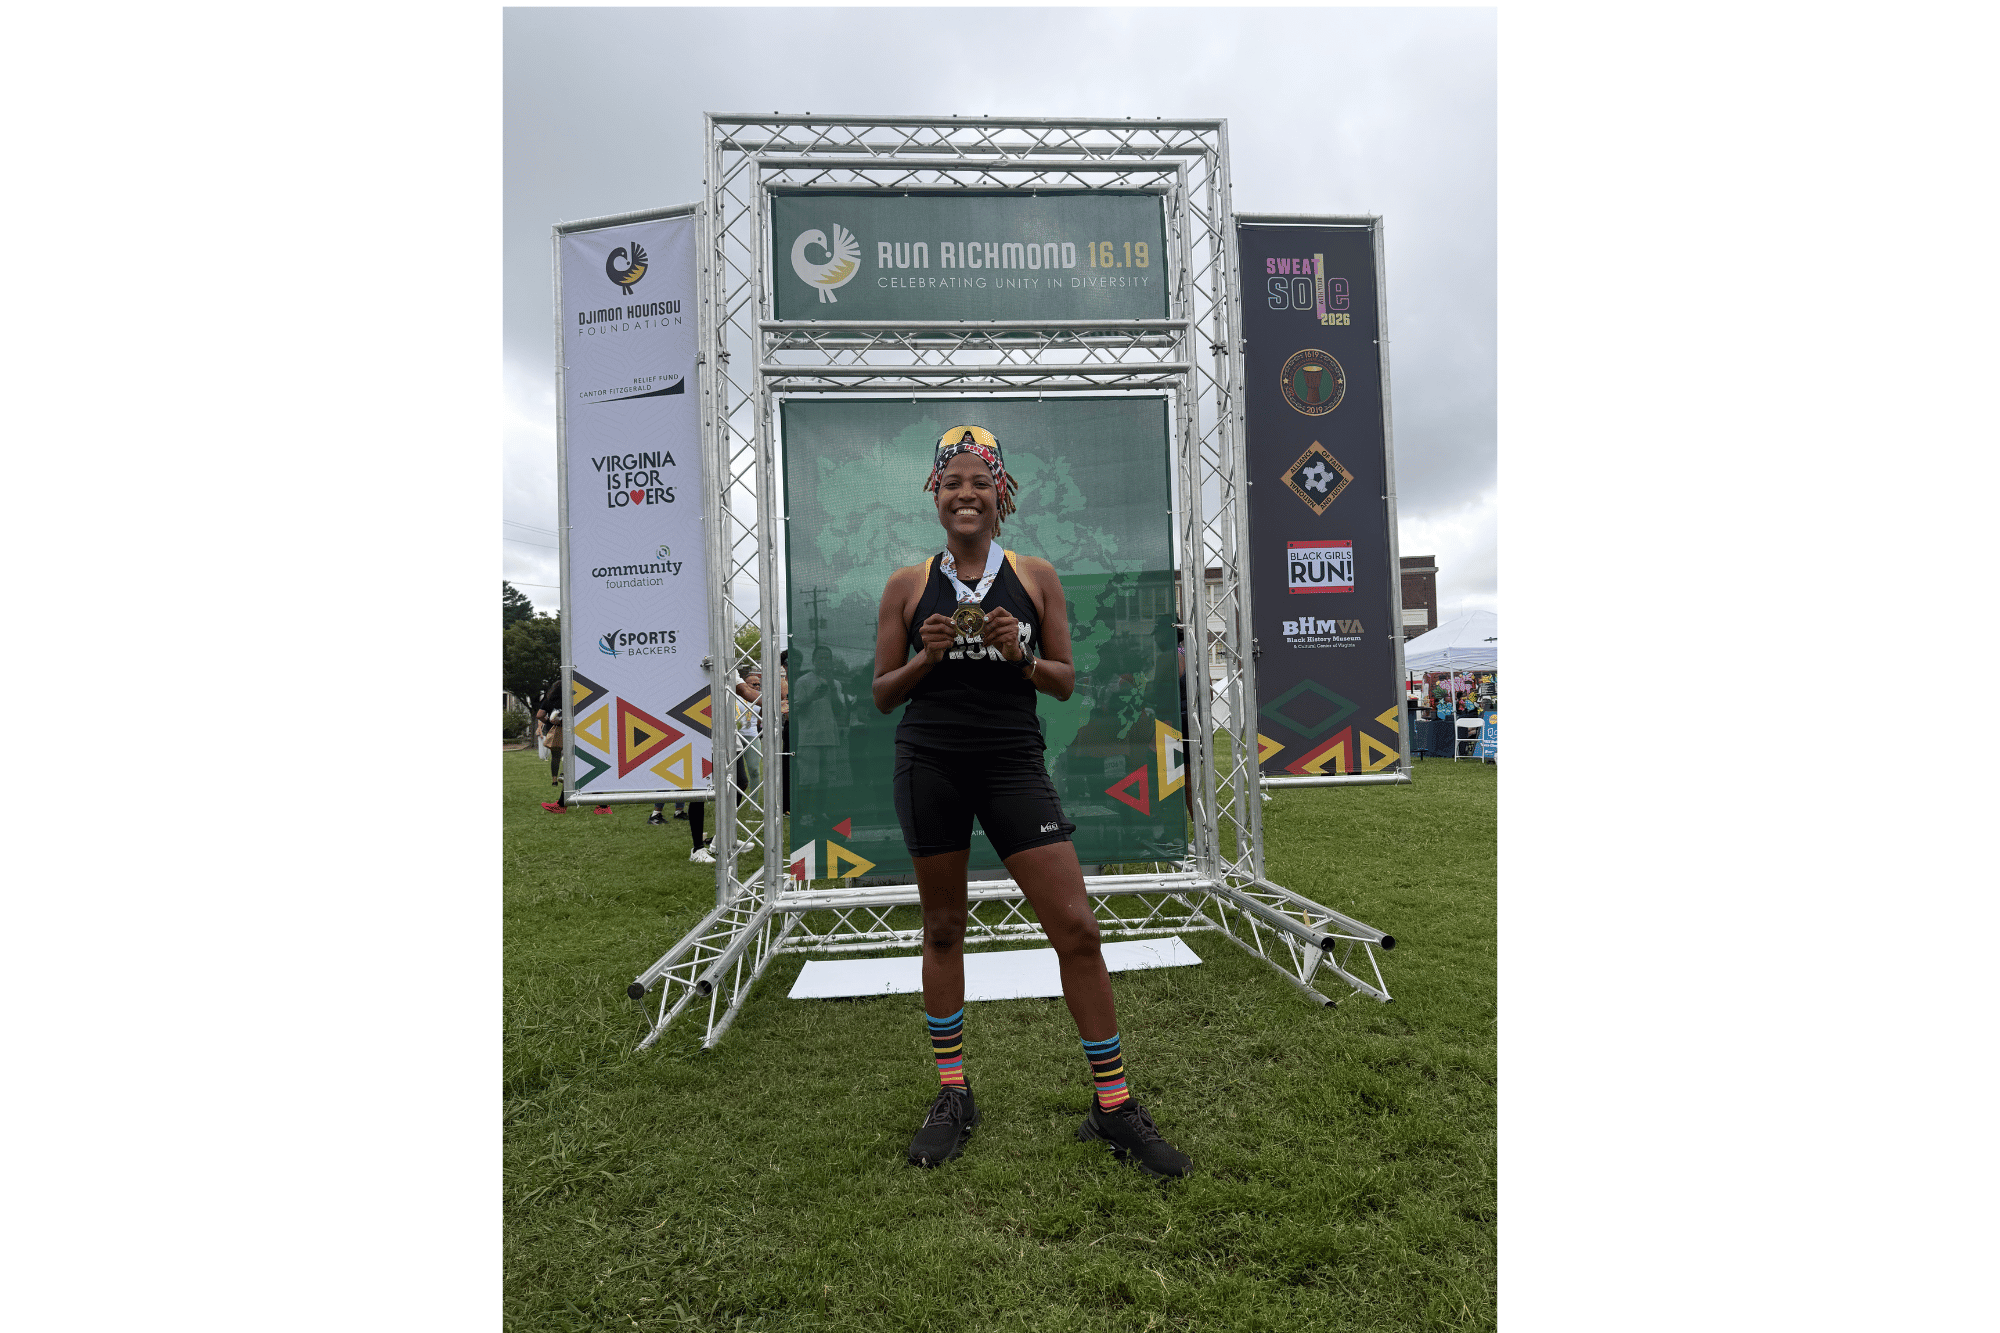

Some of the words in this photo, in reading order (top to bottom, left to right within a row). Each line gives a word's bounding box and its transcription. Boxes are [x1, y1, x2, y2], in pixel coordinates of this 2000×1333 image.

[877, 241, 928, 269] RUN
[940, 241, 1077, 270] RICHMOND
[1087, 241, 1150, 269] 16.19
[1266, 257, 1320, 275] SWEAT
[877, 277, 987, 289] CELEBRATING
[995, 277, 1039, 289] UNITY
[1047, 277, 1062, 288] IN
[1071, 276, 1150, 289] DIVERSITY
[578, 306, 623, 326] DJIMON
[627, 299, 681, 319] HOUNSOU
[1321, 313, 1351, 326] 2026
[578, 316, 682, 337] FOUNDATION
[1304, 351, 1320, 359] 1619
[633, 375, 657, 384] RELIEF
[659, 373, 679, 382] FUND
[579, 389, 607, 399] CANTOR
[609, 384, 652, 395] FITZGERALD
[1306, 406, 1323, 414] 2019
[591, 450, 677, 473] VIRGINIA
[1290, 449, 1313, 474] ALLIANCE
[1321, 450, 1330, 459] OF
[1329, 457, 1345, 474] FAITH
[607, 473, 621, 491] IS
[625, 470, 664, 489] FOR
[1289, 480, 1317, 508] NATIONAL
[1320, 497, 1332, 510] AND
[1331, 477, 1350, 499] JUSTICE
[1290, 551, 1321, 561] BLACK
[1324, 551, 1352, 560] GIRLS
[591, 560, 683, 578] community
[1290, 560, 1353, 584] RUN!
[606, 576, 664, 589] foundation
[619, 630, 677, 647] SPORTS
[628, 645, 677, 656] BACKERS
